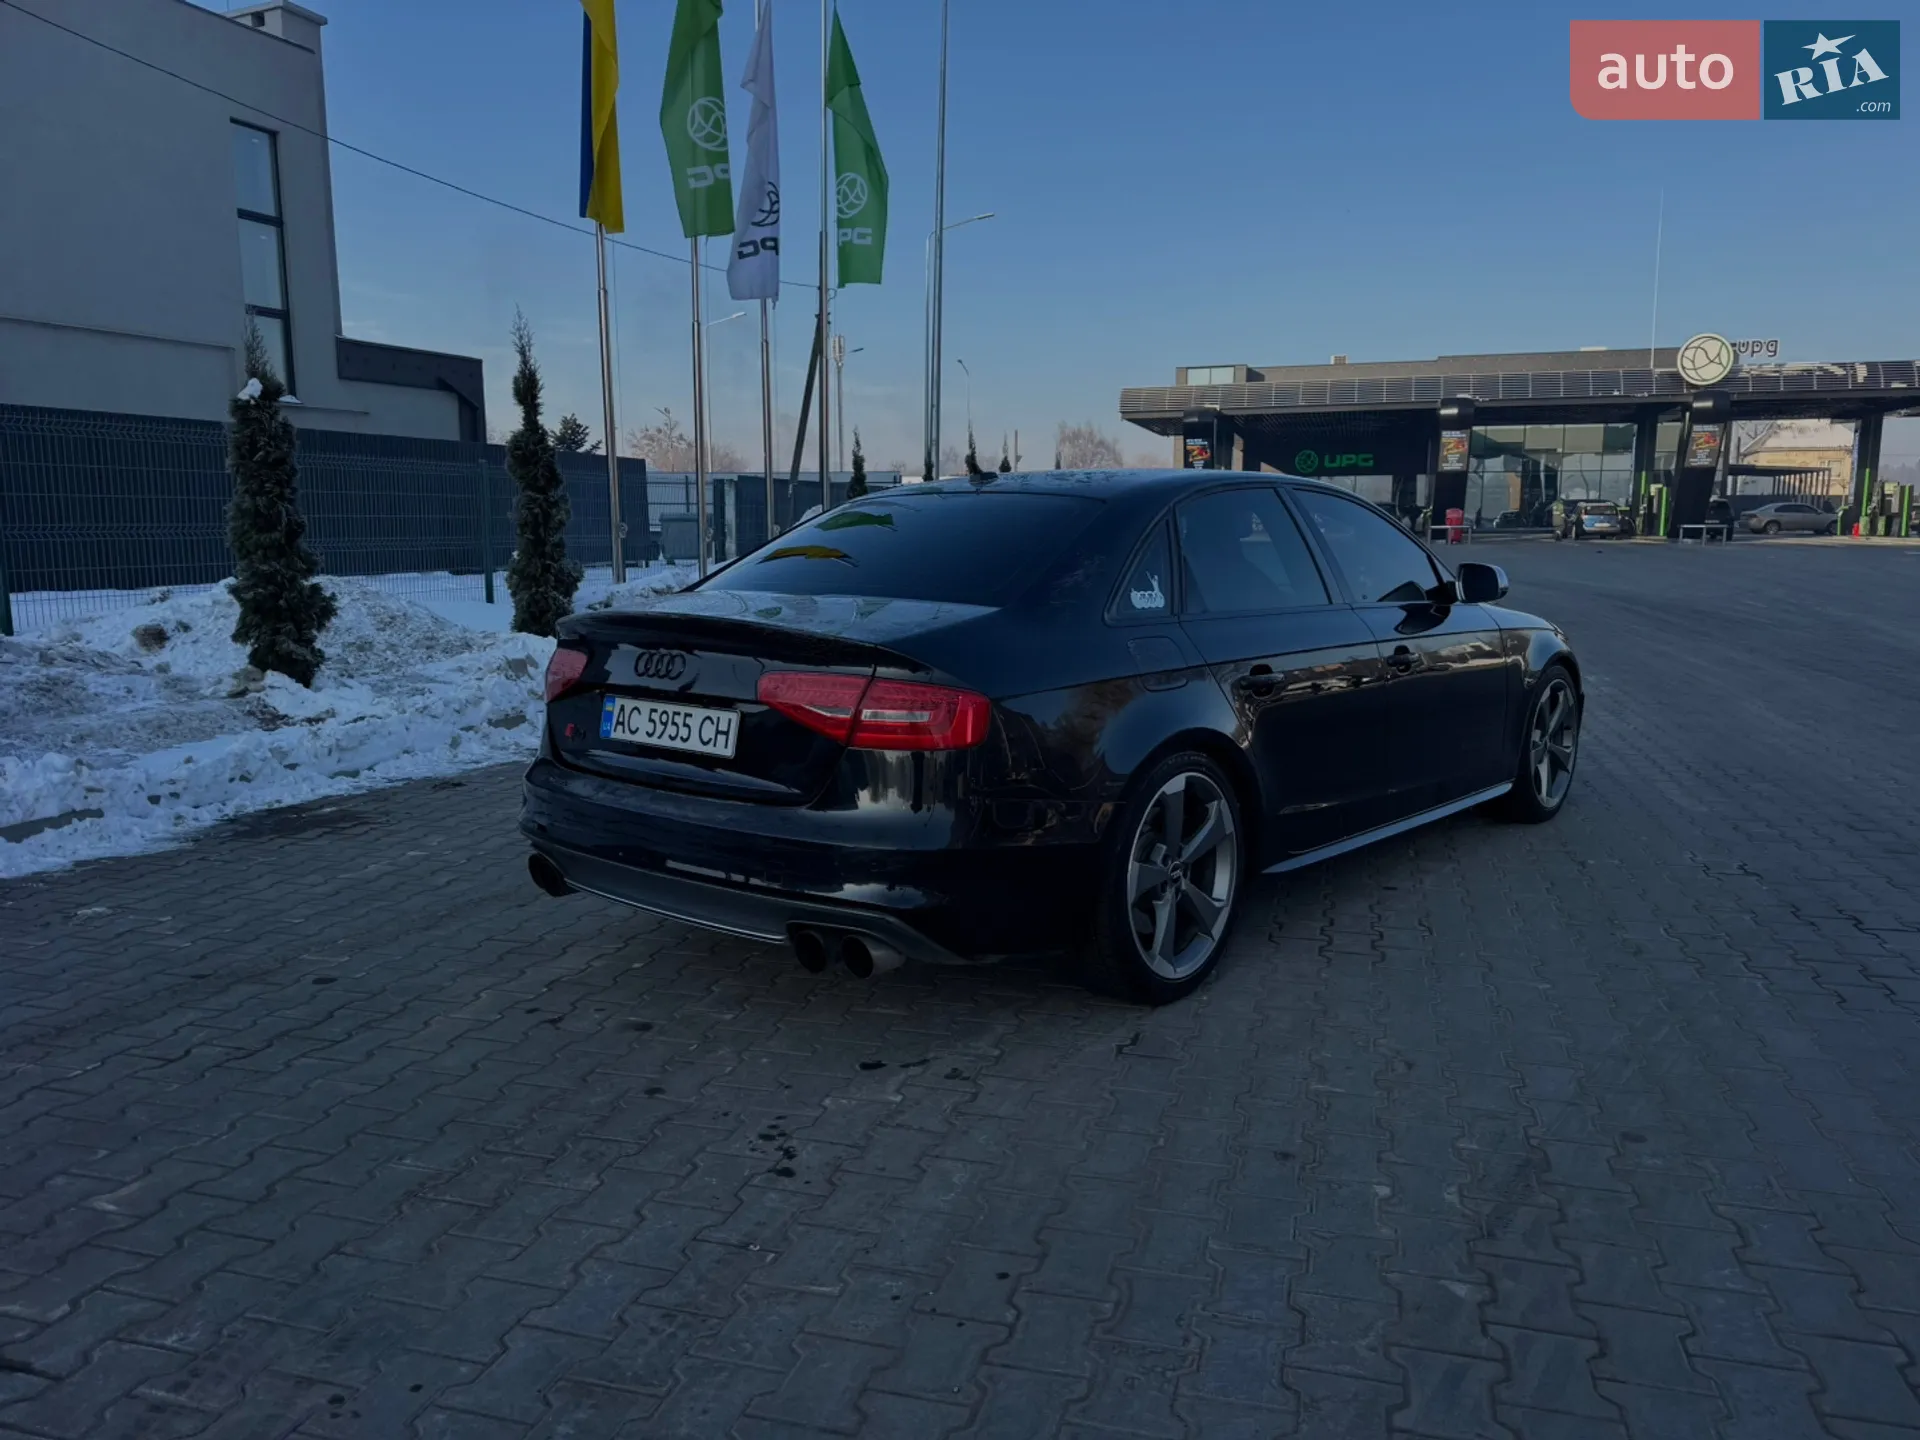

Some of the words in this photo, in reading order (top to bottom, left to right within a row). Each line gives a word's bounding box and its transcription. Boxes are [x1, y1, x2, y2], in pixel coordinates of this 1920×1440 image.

[1737, 339, 1778, 357] upg
[1323, 451, 1375, 469] UPG
[613, 704, 641, 735] AC
[645, 708, 693, 743] 5955
[698, 715, 732, 749] CH
